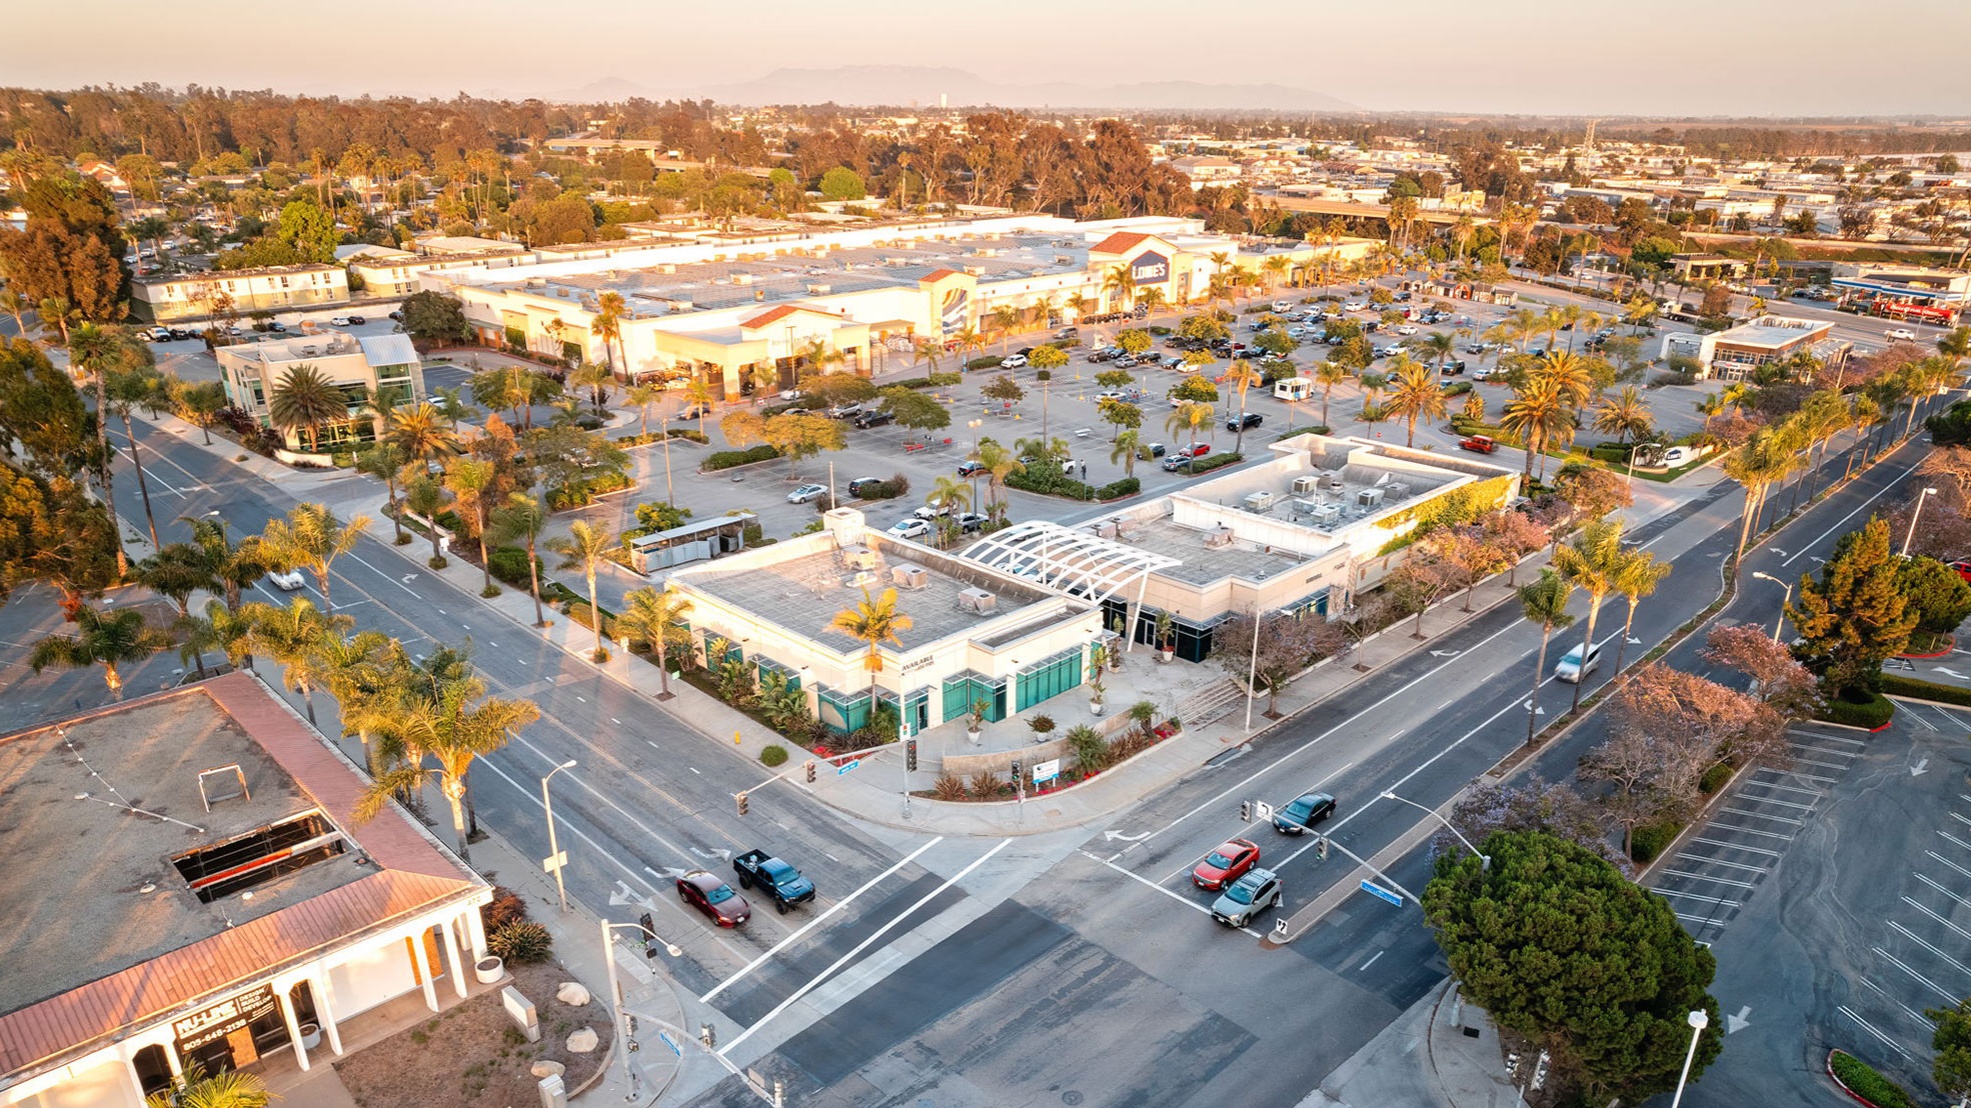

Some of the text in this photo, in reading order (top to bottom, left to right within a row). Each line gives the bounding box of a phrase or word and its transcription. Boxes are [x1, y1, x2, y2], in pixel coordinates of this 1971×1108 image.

[1132, 262, 1166, 280] LOWE'S
[902, 655, 933, 671] AVAILABLE
[239, 988, 265, 1001] DESIGN
[240, 995, 260, 1007] BUILD
[242, 995, 272, 1012] DEVELOP
[175, 1000, 237, 1034] NU-LINE
